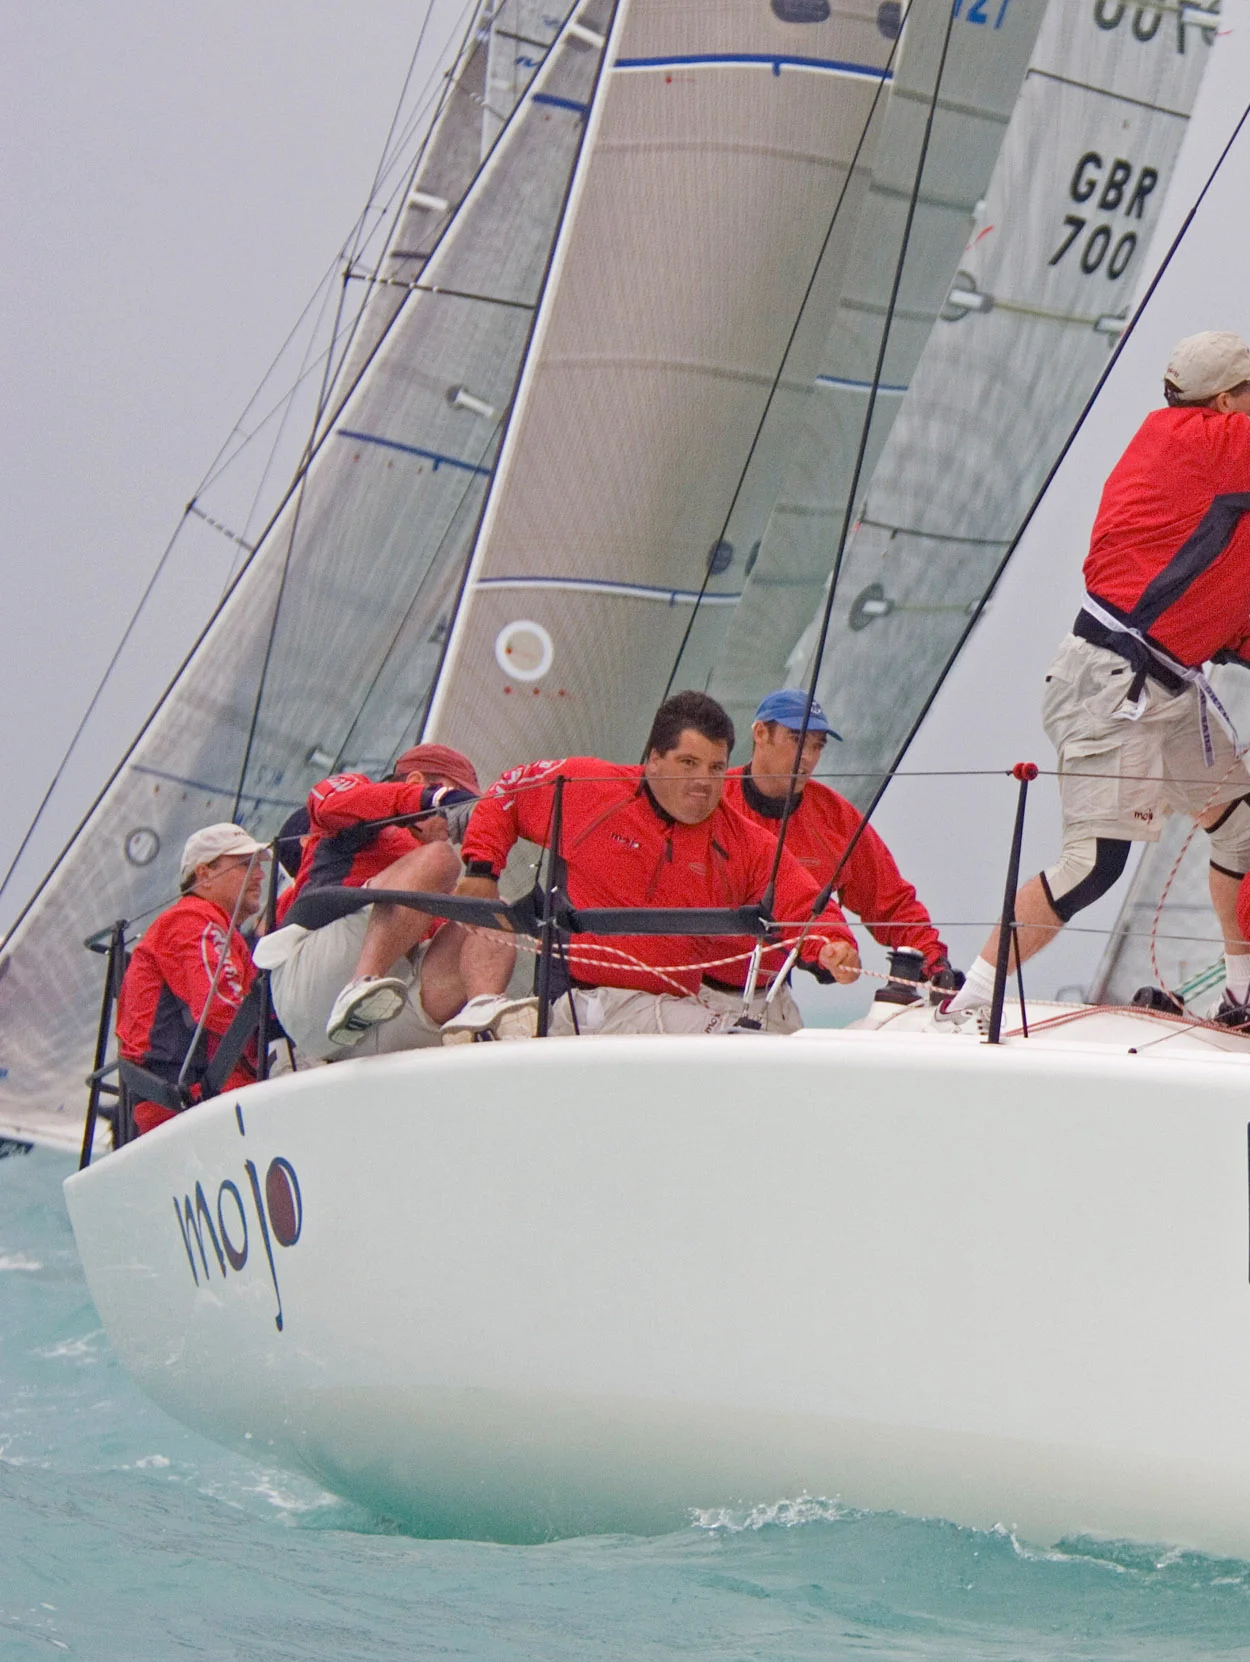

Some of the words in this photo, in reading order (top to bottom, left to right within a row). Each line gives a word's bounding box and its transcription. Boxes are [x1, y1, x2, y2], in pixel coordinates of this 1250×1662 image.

[1070, 151, 1158, 219] GBR
[1048, 214, 1137, 280] 700
[172, 1102, 302, 1332] mojo
